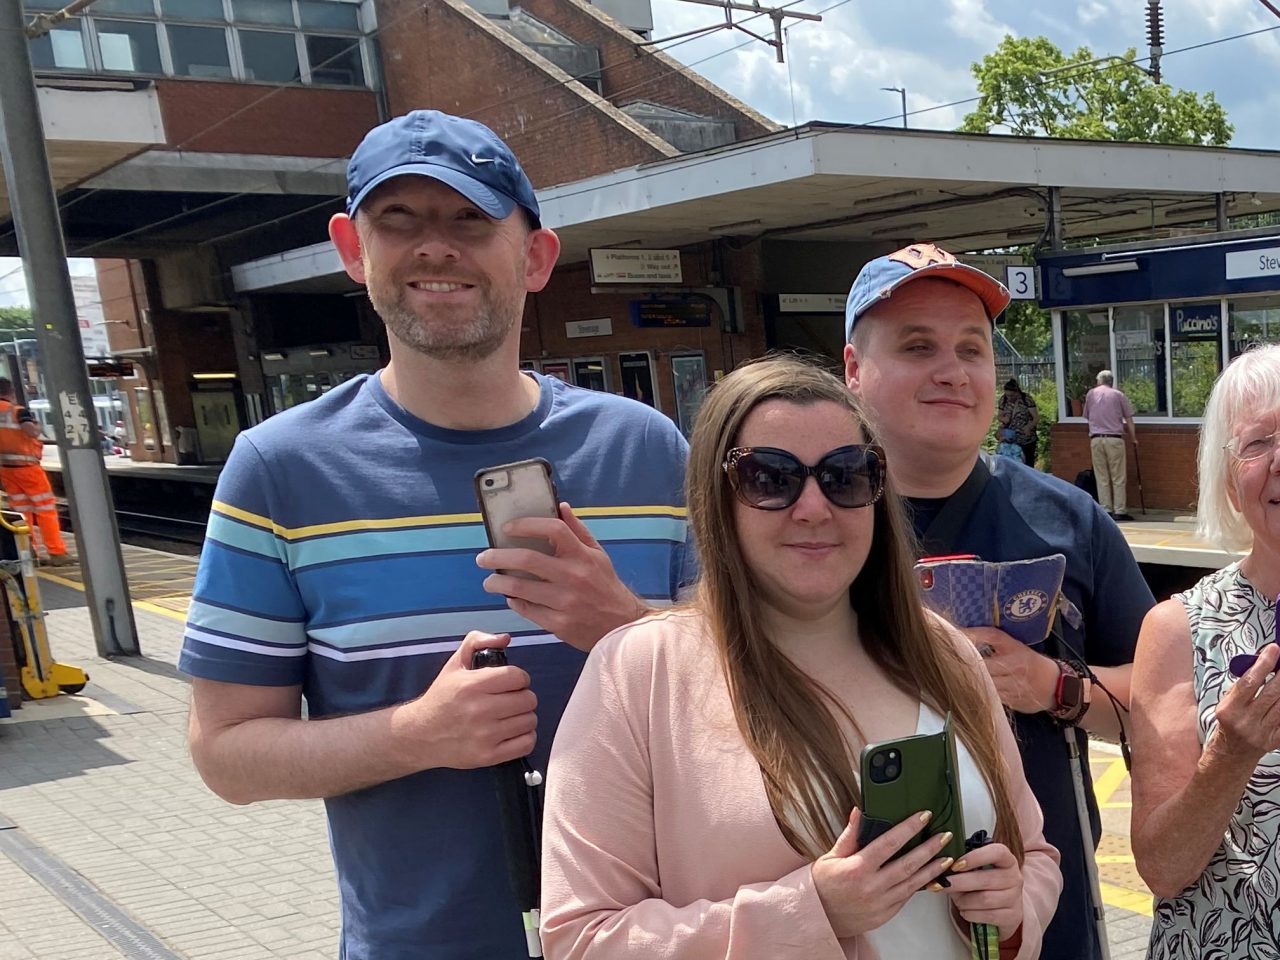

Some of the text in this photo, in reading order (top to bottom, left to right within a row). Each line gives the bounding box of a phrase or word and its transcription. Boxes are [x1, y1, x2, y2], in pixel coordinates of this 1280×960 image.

[1015, 271, 1028, 295] 3
[1176, 309, 1218, 333] Puccino's
[67, 393, 77, 406] E
[66, 423, 89, 434] 2 7
